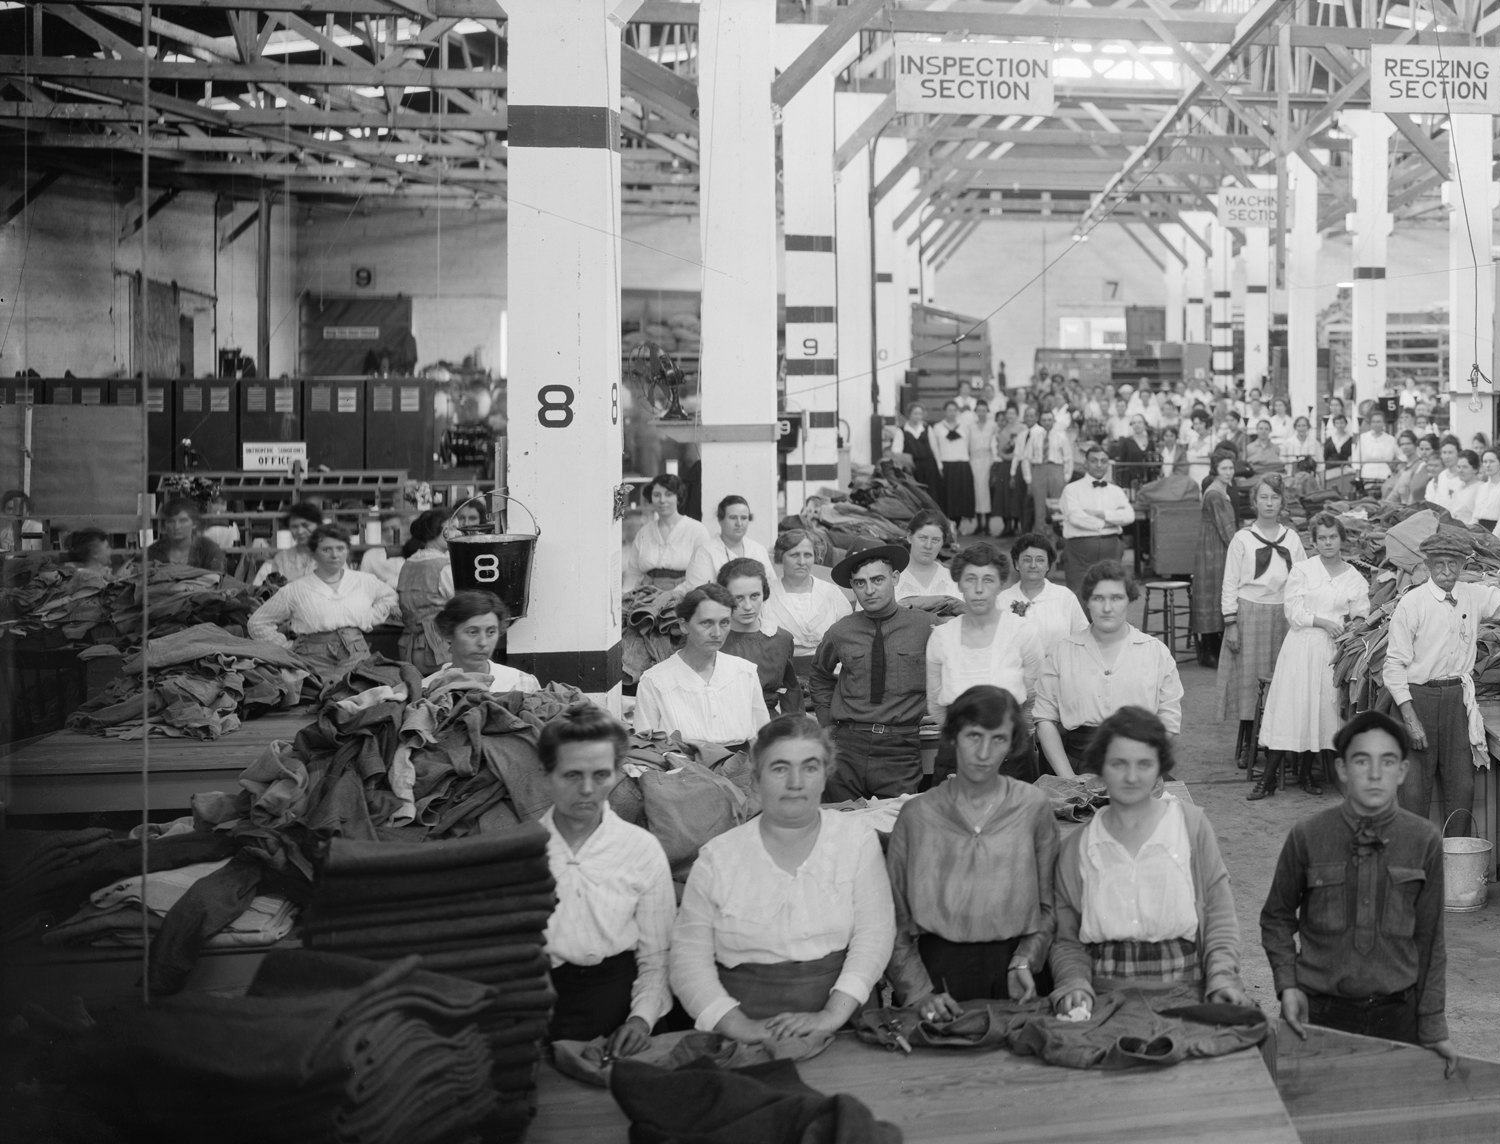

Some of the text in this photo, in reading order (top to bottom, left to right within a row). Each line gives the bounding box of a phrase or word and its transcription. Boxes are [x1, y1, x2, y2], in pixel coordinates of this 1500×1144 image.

[900, 55, 1049, 78] INSPECTION
[1384, 58, 1490, 79] RESIZING
[920, 79, 1030, 101] SECTION
[1389, 80, 1488, 100] SECTION
[1225, 195, 1288, 207] MACHIN
[1228, 209, 1278, 221] SECTIO
[355, 266, 372, 288] 9
[1106, 280, 1119, 299] 7
[803, 338, 818, 356] 9
[1253, 344, 1261, 353] 4
[1367, 353, 1379, 367] 5
[537, 384, 575, 428] 8
[611, 382, 618, 425] 8
[1387, 400, 1397, 411] 5
[474, 554, 500, 583] 8
